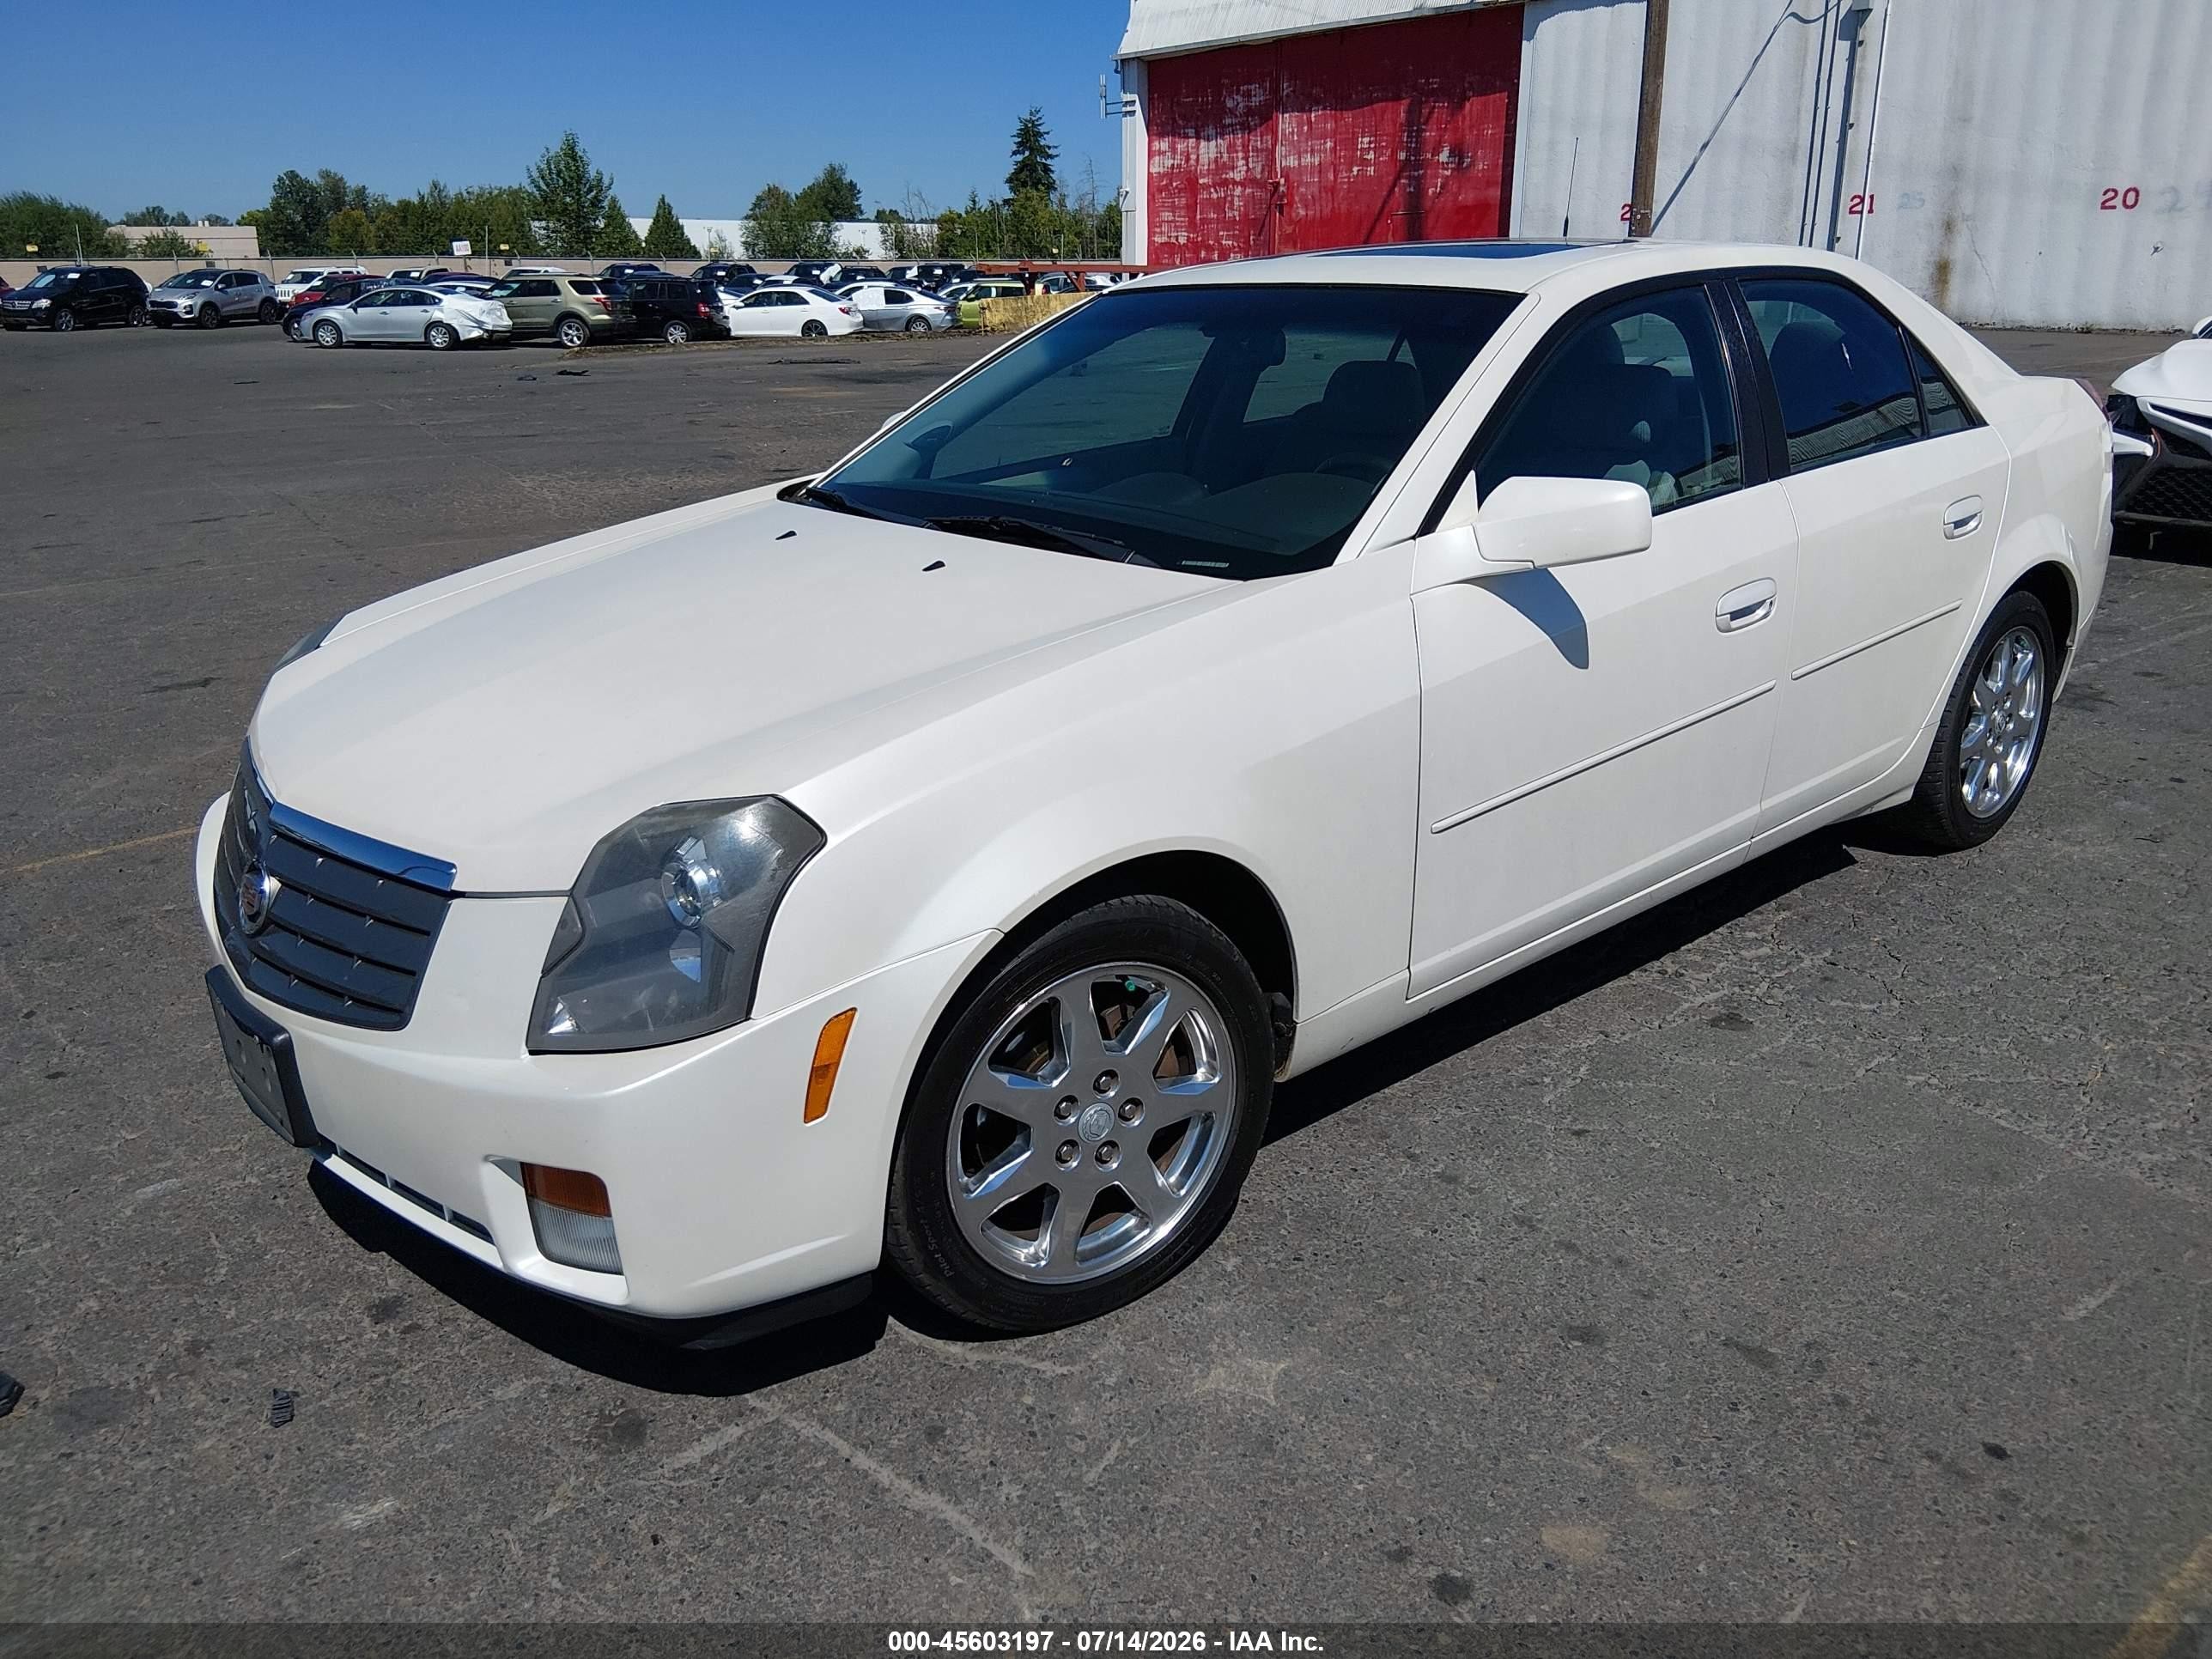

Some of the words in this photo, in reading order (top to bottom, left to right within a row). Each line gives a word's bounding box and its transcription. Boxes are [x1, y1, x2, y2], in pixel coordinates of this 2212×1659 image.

[1849, 194, 1875, 215] 21
[2100, 186, 2140, 210] 20
[919, 1218, 939, 1251] Sport
[933, 1253, 955, 1278] Pilot
